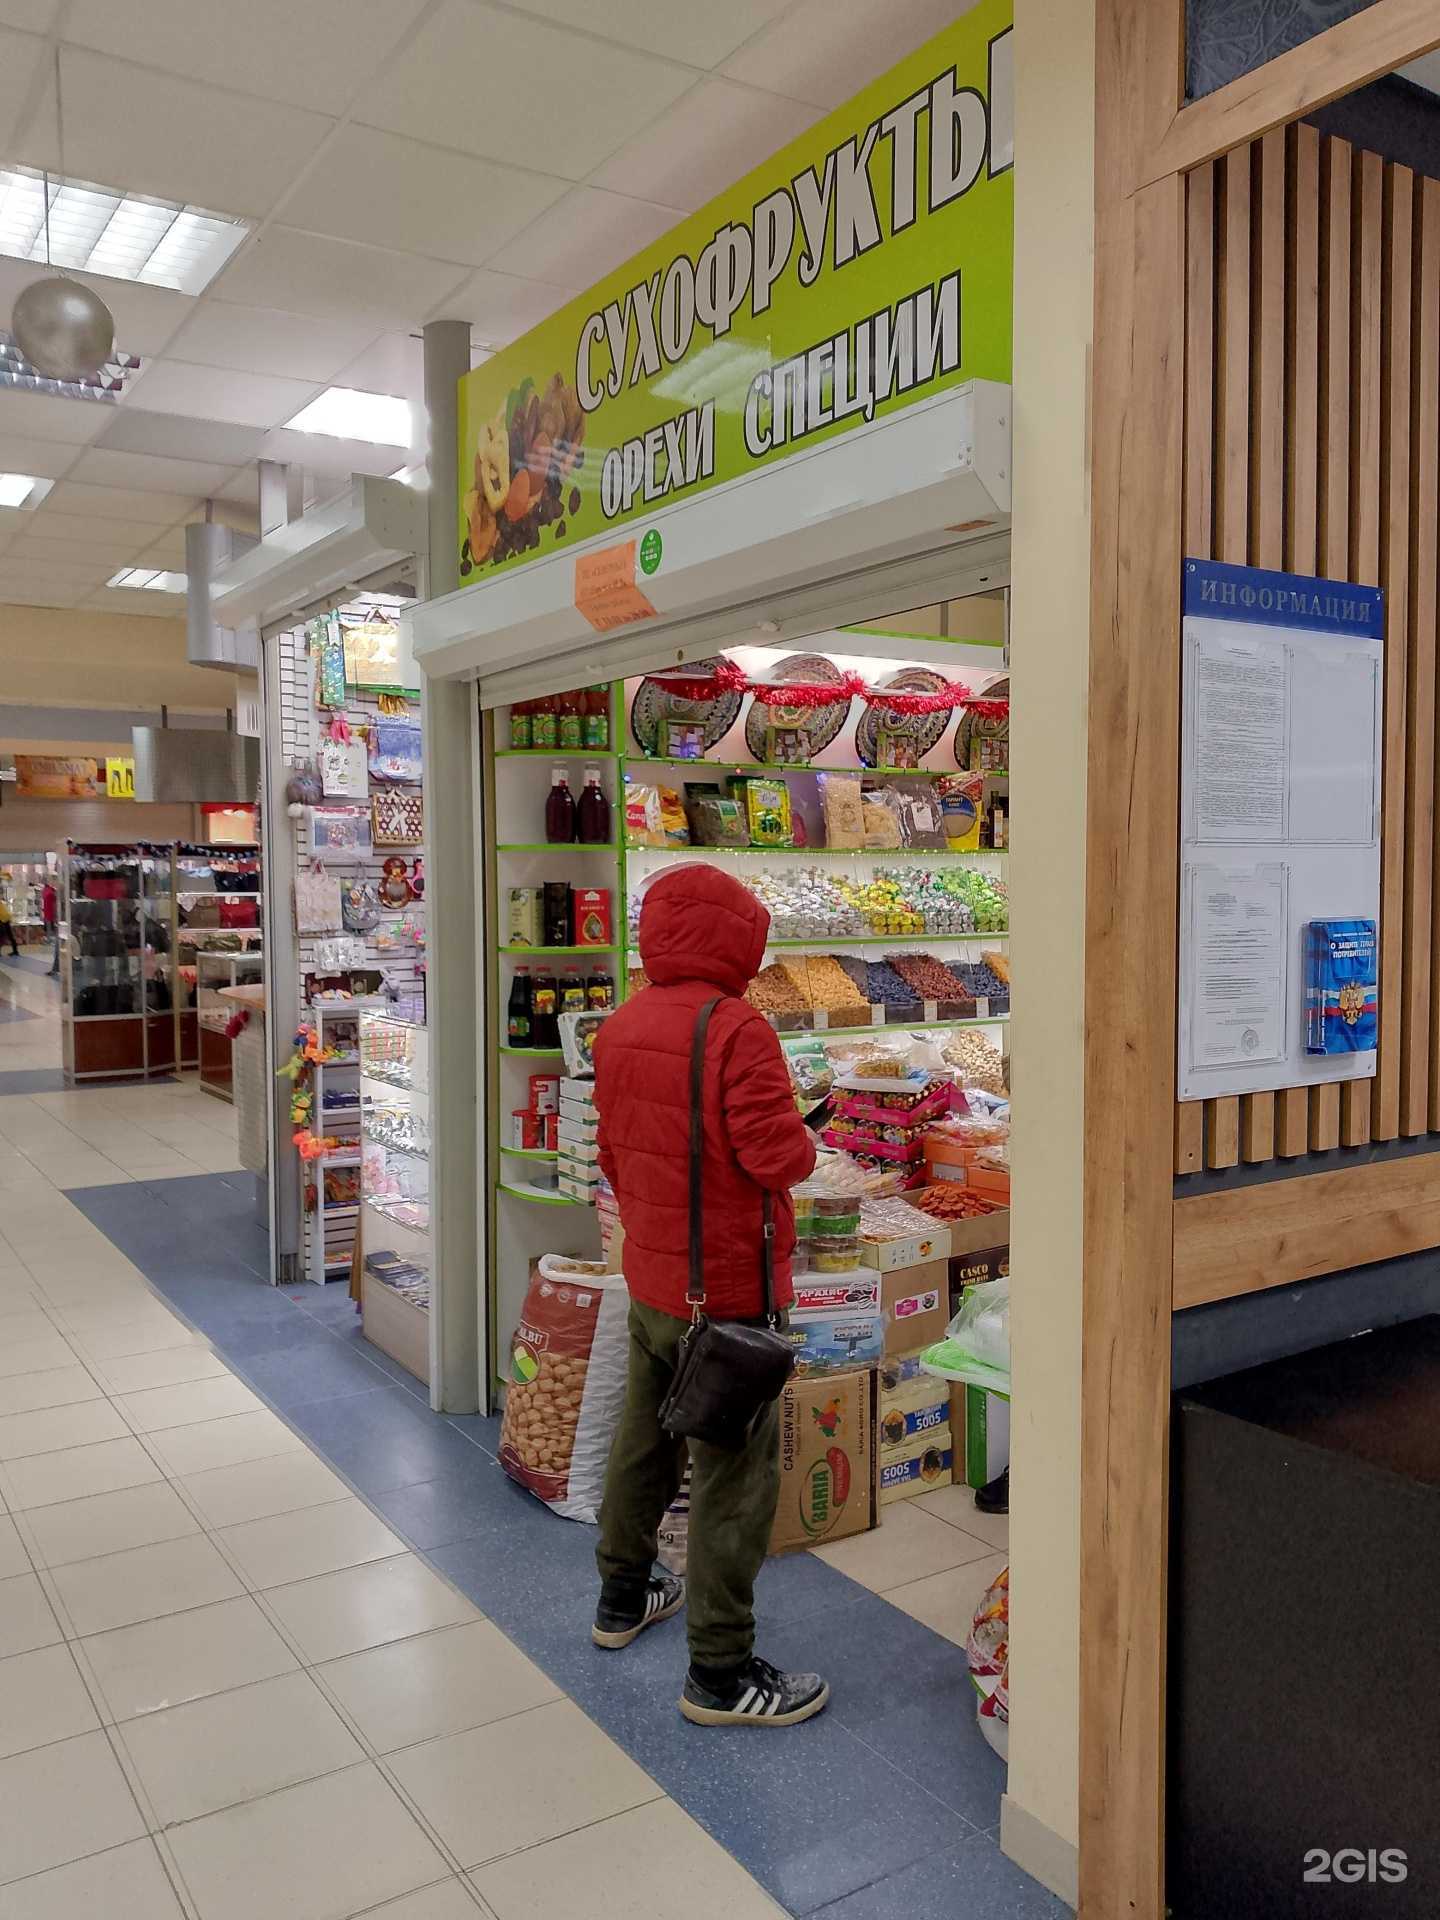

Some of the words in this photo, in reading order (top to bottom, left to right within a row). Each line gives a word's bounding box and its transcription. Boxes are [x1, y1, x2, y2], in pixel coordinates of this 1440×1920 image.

[576, 25, 1014, 413] СУХОФРУКТЫ
[601, 398, 716, 519] ОРЕХИ
[744, 269, 961, 458] СПЕЦИИ
[1200, 579, 1372, 622] ИНФОРМАЦИЯ
[960, 1264, 990, 1279] CASCO
[783, 1388, 794, 1417] NUTS
[916, 1412, 941, 1431] 5005
[783, 1419, 794, 1471] CASHEW
[811, 1471, 829, 1524] BARIA
